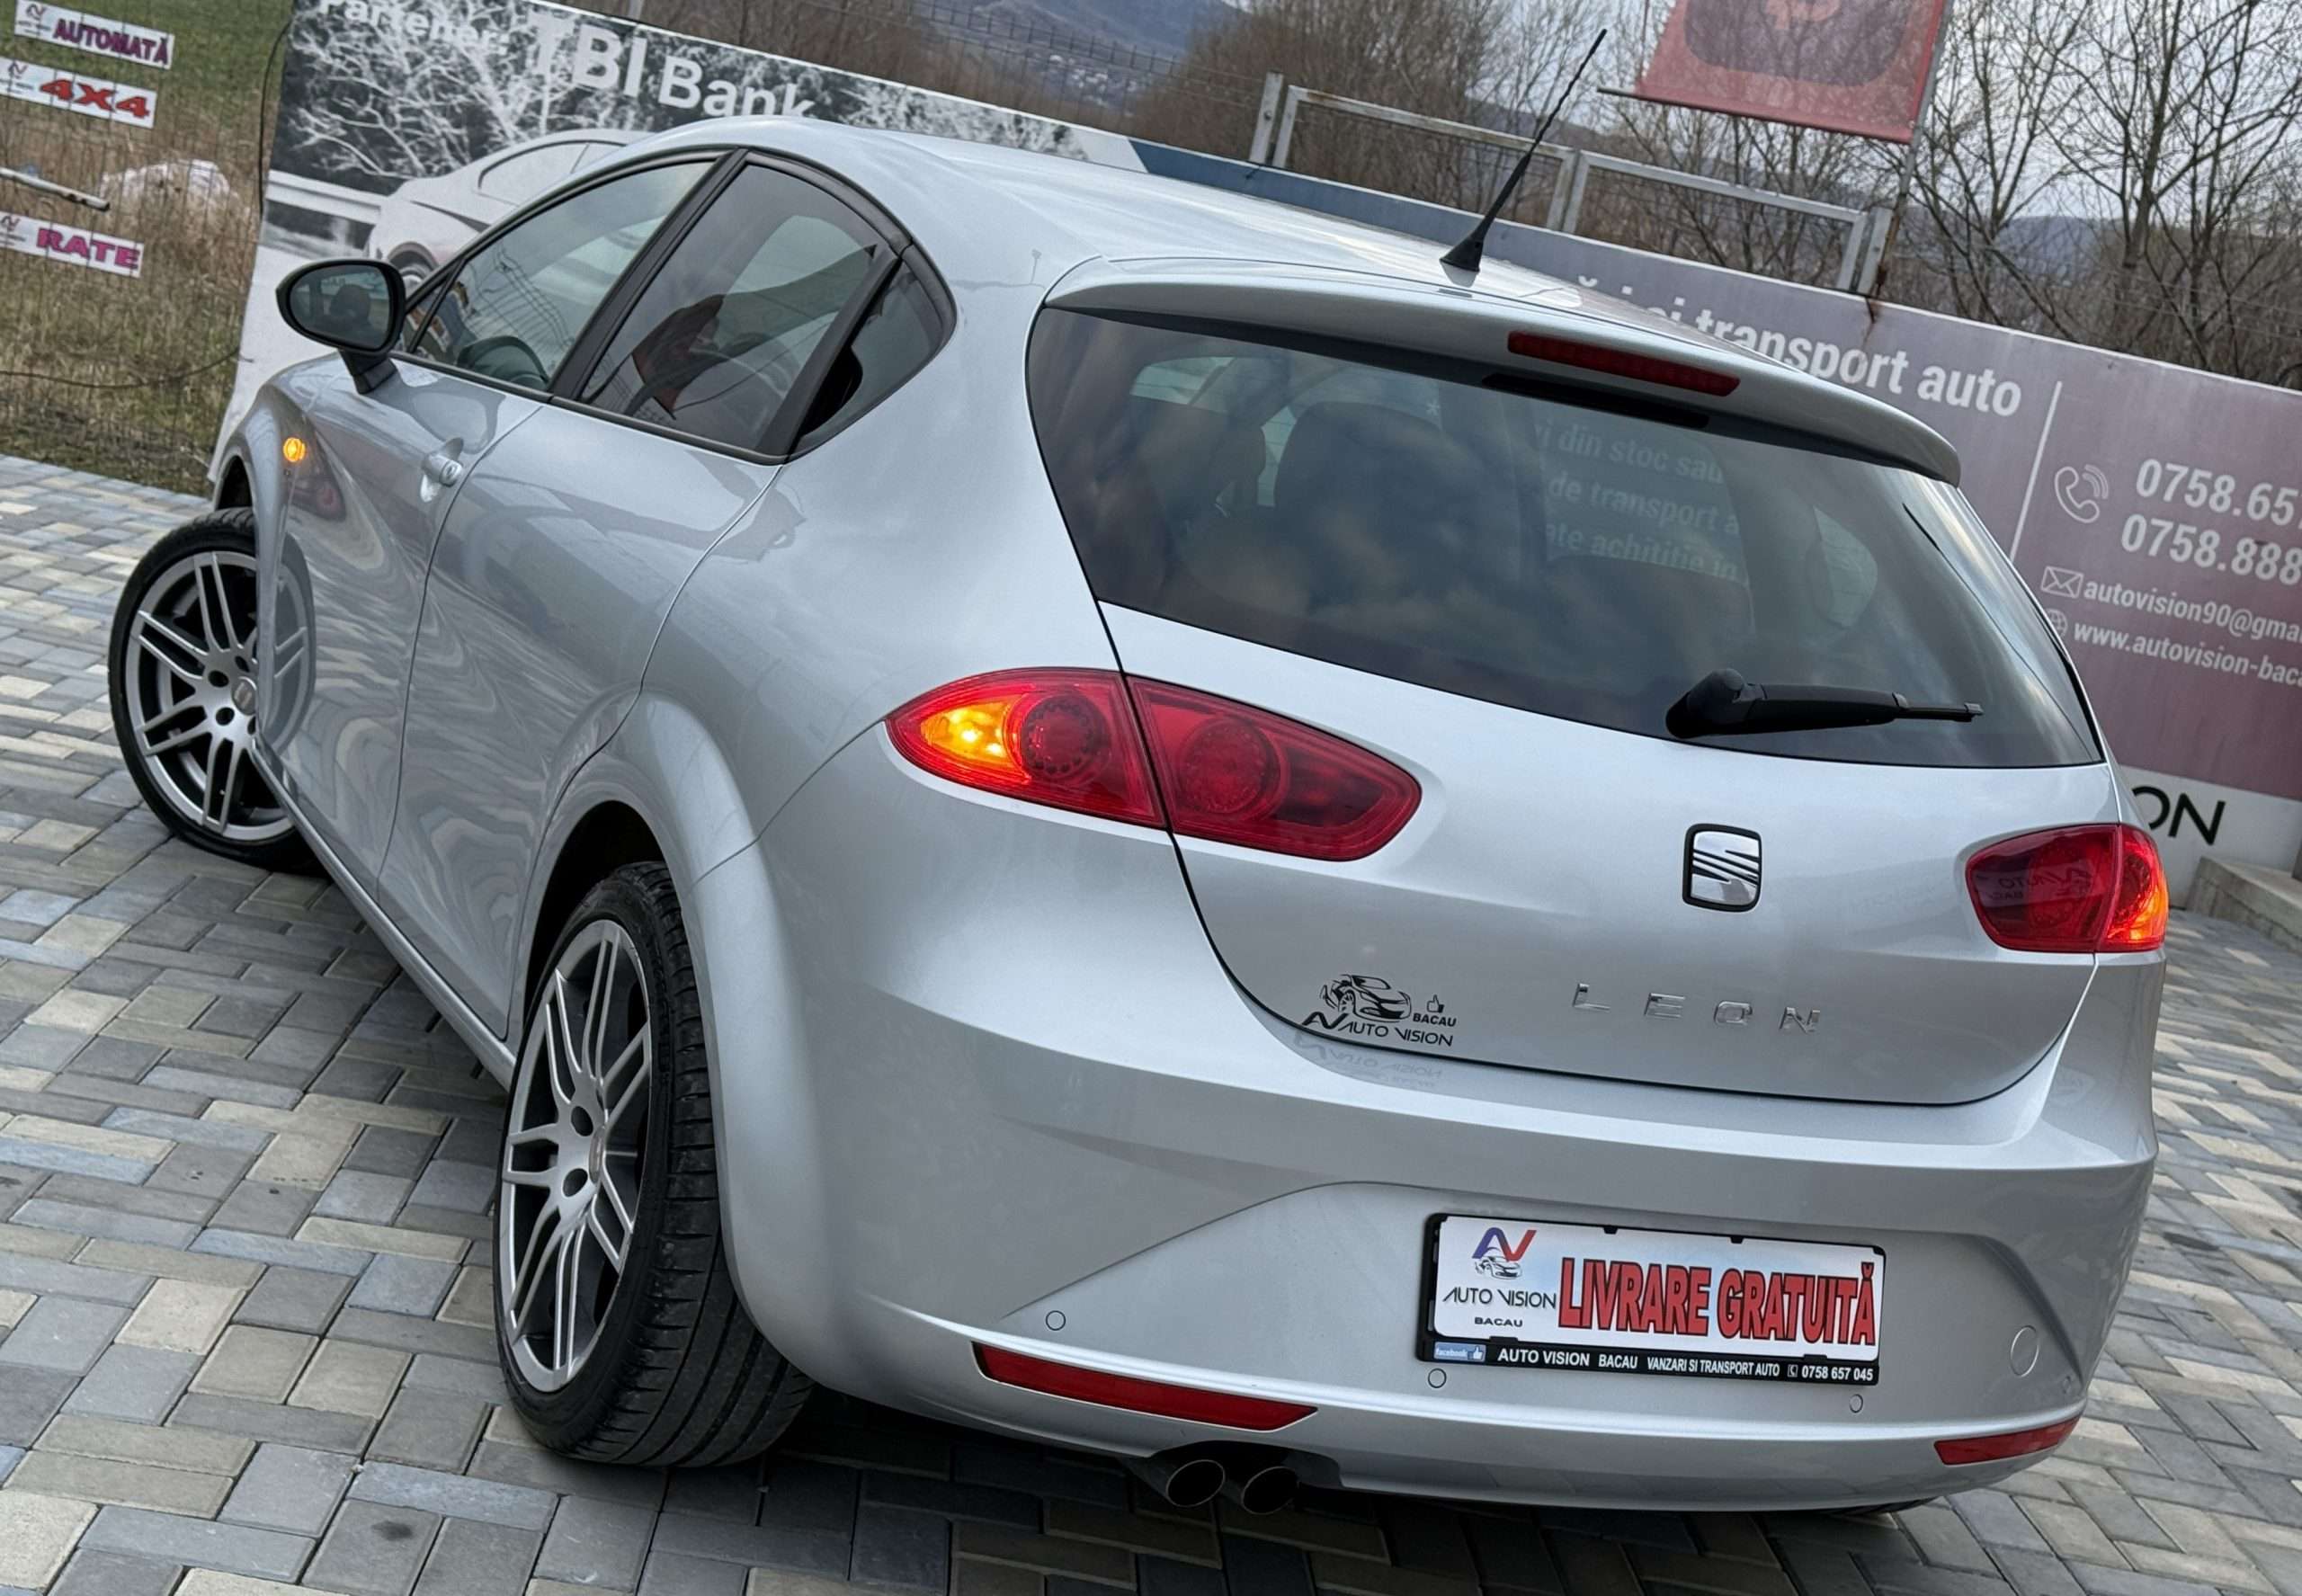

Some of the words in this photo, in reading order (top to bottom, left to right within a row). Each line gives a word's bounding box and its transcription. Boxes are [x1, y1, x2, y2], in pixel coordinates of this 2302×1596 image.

[52, 18, 169, 66] AUTOMATĂ
[658, 56, 815, 117] Bank
[37, 227, 140, 270] RATE
[1696, 309, 1909, 394] transport
[1917, 365, 2022, 416] auto
[1609, 441, 1669, 472] stoc
[1590, 479, 1719, 531] transport
[2136, 459, 2302, 530] 0758.65
[1413, 1012, 1458, 1028] BACAU
[1573, 983, 1821, 1034] LEON
[1338, 1021, 1389, 1038] AUTO
[1395, 1027, 1454, 1047] VISION
[1442, 1287, 1493, 1305] AUTO
[1497, 1288, 1557, 1309] VISION
[1558, 1257, 1712, 1337] LIVRARE
[1717, 1262, 1877, 1346] GRATUITĂ
[1474, 1317, 1523, 1327] BACAU
[1497, 1348, 1539, 1364] AUTO
[1542, 1351, 1591, 1366] VISION
[1598, 1354, 1638, 1369] BACAU
[1647, 1356, 1687, 1372] VANZARI
[1688, 1359, 1698, 1372] SI
[1700, 1360, 1756, 1376] TRANSPORT
[1754, 1363, 1780, 1378] AUTO
[1801, 1365, 1829, 1379] 0758
[1831, 1366, 1851, 1380] 657
[1853, 1367, 1874, 1381] 045
